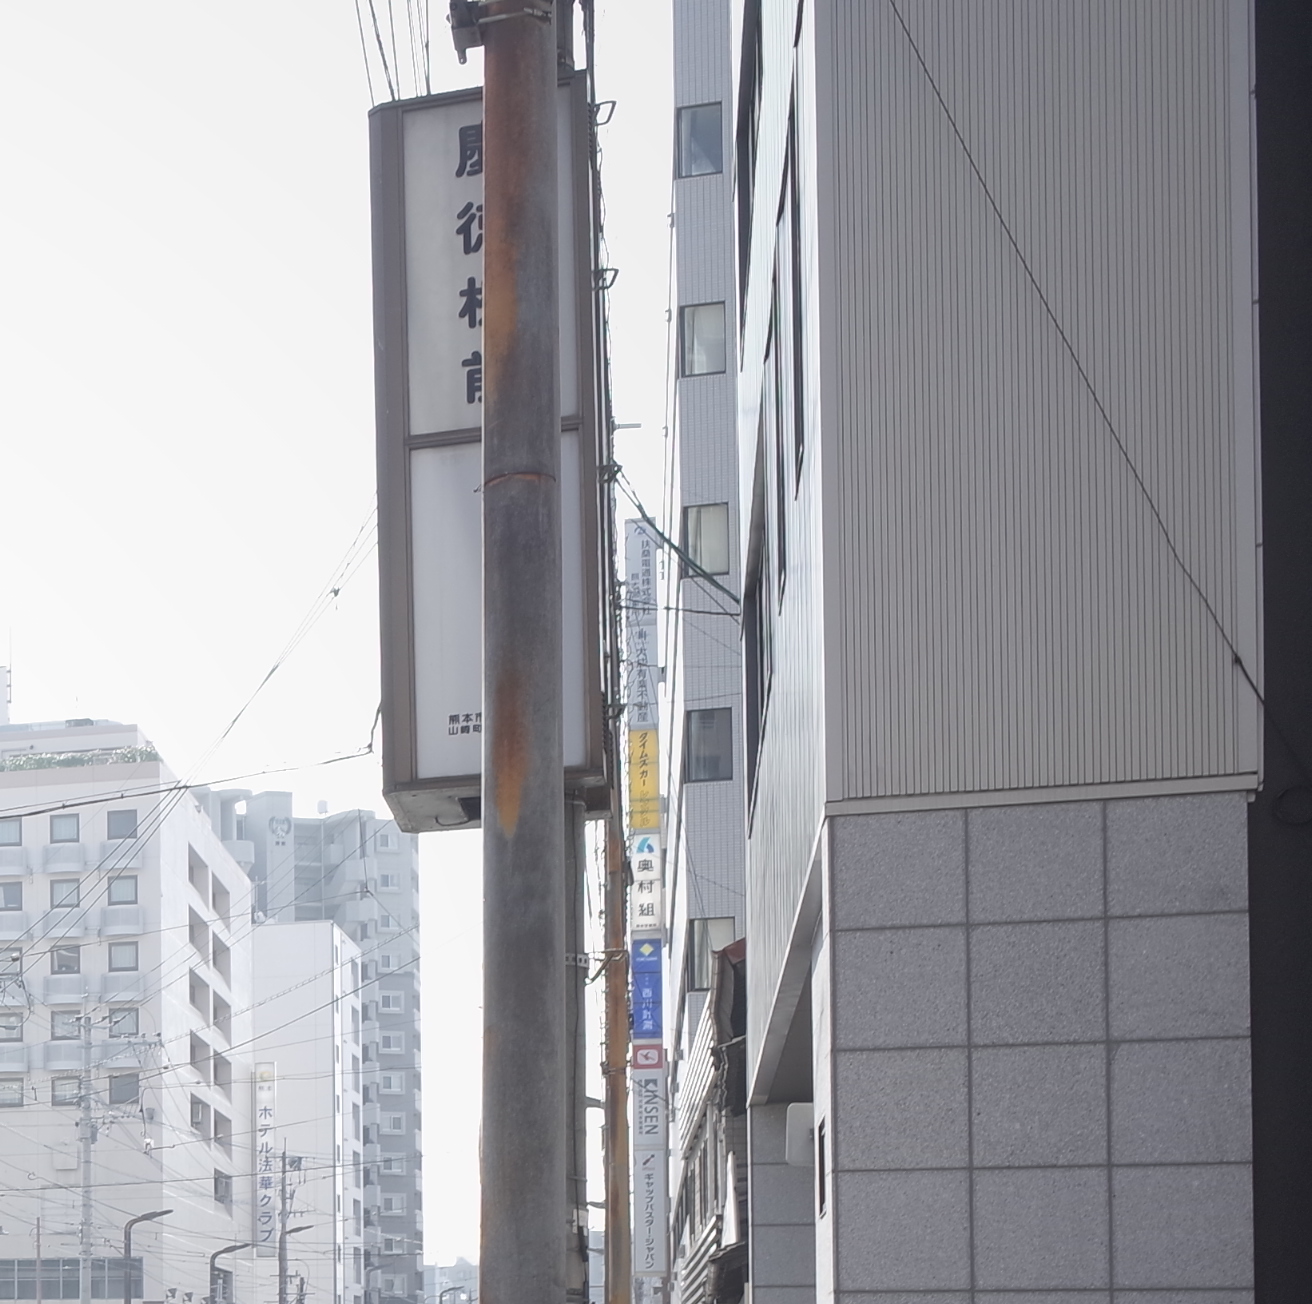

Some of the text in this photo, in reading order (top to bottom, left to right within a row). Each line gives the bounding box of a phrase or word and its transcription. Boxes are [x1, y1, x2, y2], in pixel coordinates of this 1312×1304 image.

[636, 858, 656, 917] 奥村組
[258, 1105, 274, 1243] ホテル法華クラブ
